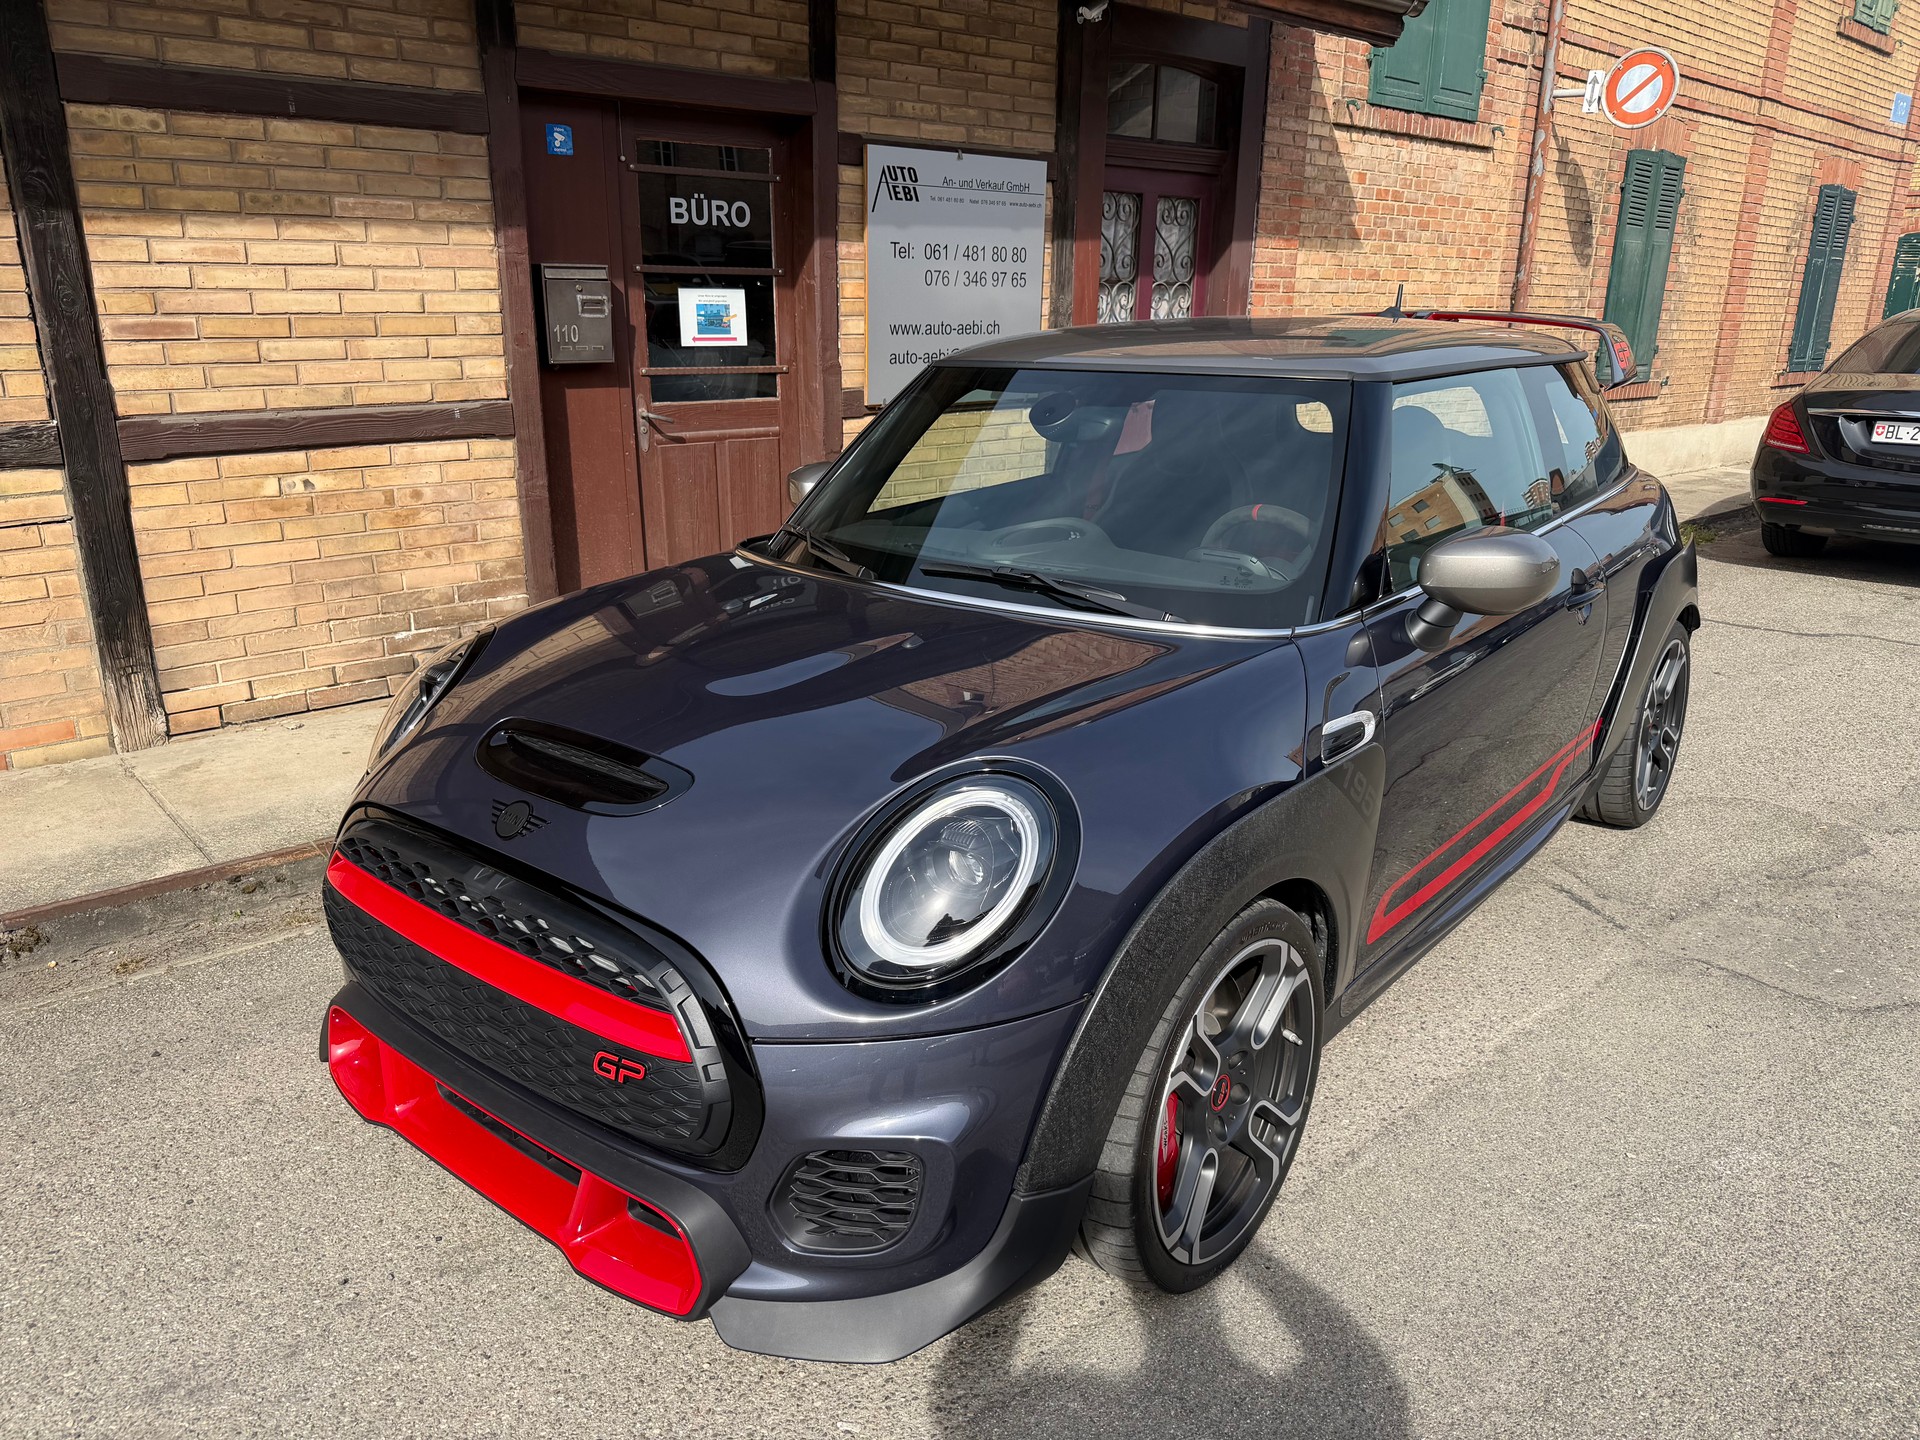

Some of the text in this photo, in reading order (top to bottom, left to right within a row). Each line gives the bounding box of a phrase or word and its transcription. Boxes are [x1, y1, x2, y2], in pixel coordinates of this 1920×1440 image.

[942, 176, 1030, 193] An- und Verkauf GmbH
[670, 193, 751, 228] BÜRO
[890, 241, 1027, 263] Tel: 061 / 481 80 80
[924, 269, 1027, 288] 076 / 346 97 65
[554, 324, 579, 343] 110
[889, 320, 1001, 336] www.auto-aebi.ch
[889, 348, 960, 365] auto-aeb
[593, 1051, 645, 1083] GP
